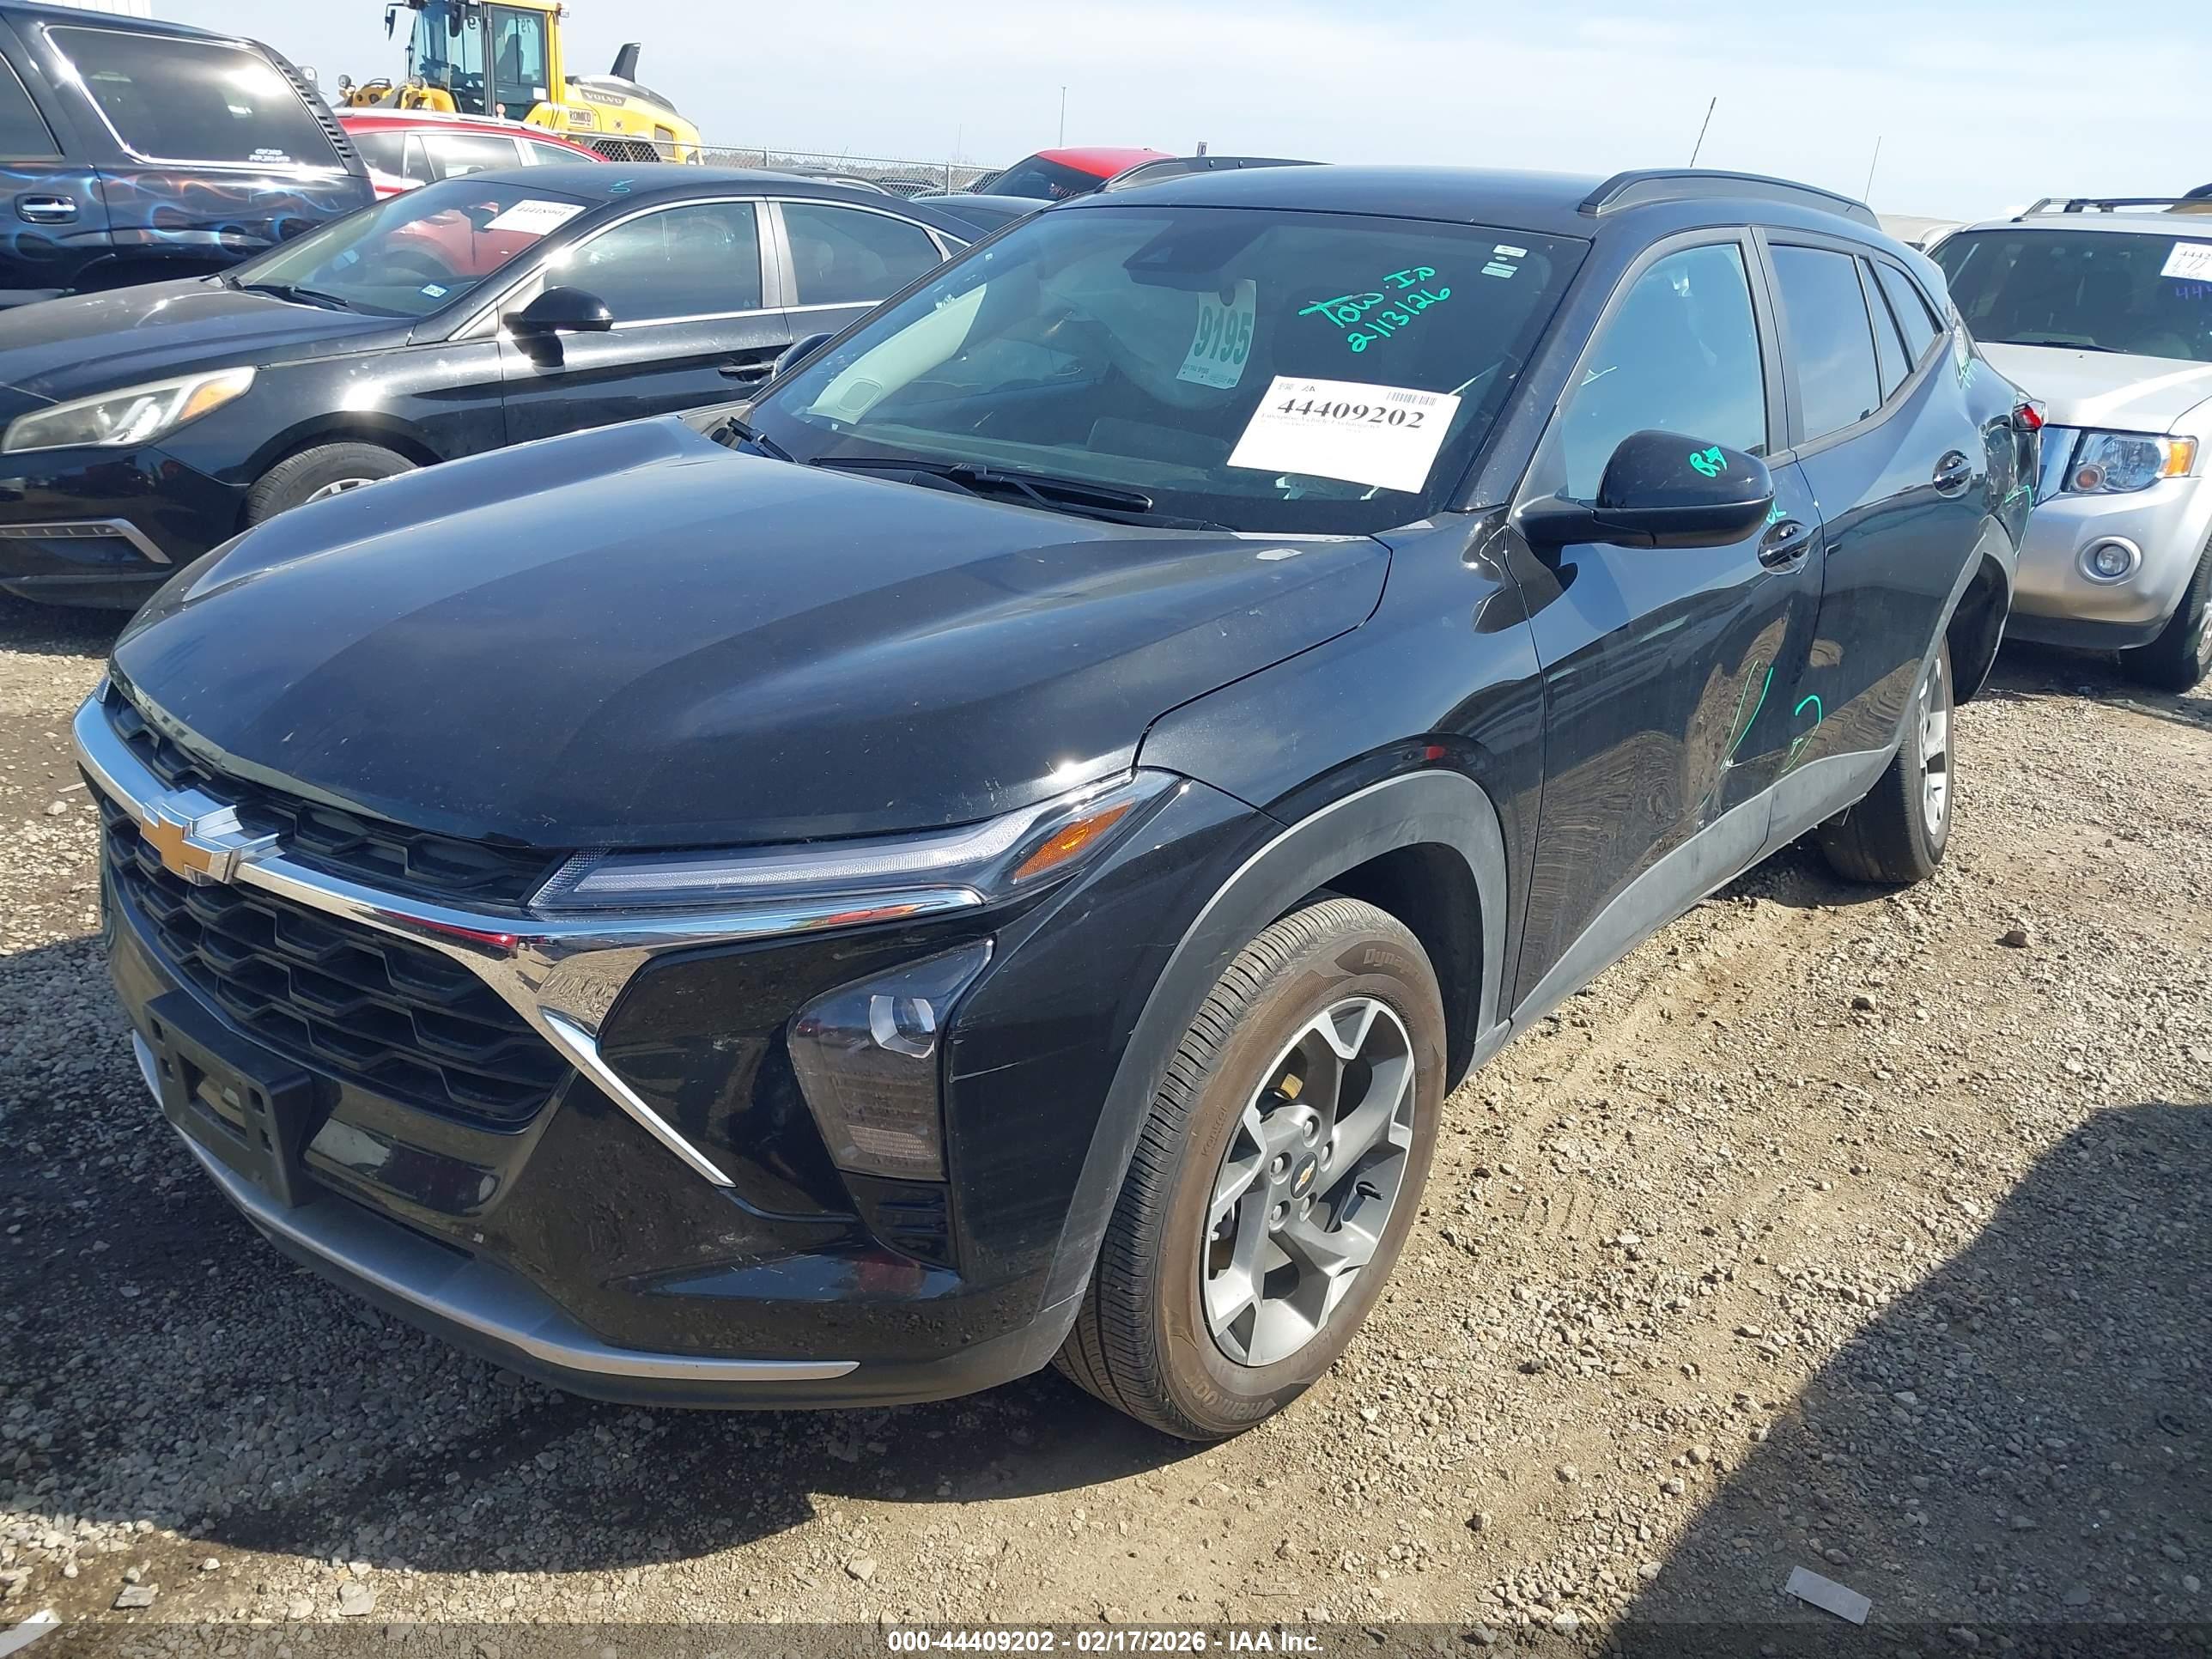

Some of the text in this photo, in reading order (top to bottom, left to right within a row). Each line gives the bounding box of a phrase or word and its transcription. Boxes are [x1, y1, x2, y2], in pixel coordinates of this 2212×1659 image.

[584, 92, 622, 104] VOLVO
[1194, 306, 1253, 364] 9195
[1347, 288, 1451, 353] 2/13/26
[1278, 398, 1425, 428] 44409202
